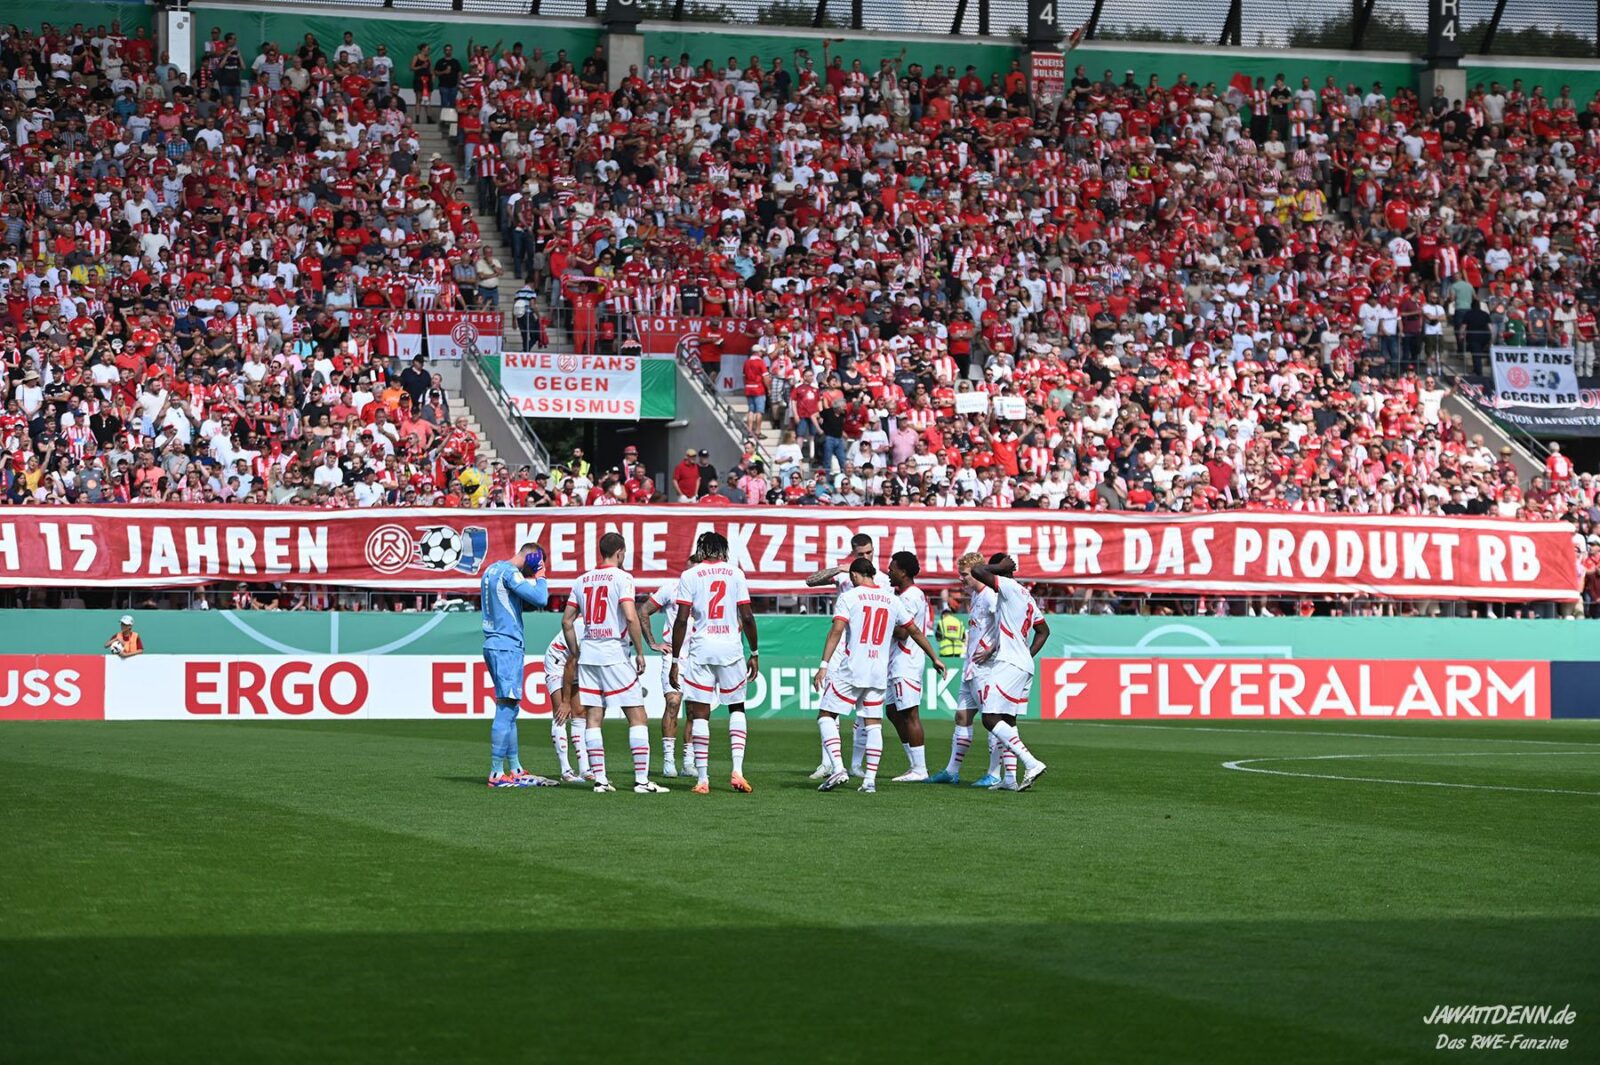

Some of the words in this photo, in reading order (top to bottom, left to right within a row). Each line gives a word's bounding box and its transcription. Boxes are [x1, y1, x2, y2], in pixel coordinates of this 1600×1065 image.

[1039, 2, 1055, 25] 4
[1441, 19, 1457, 42] 4
[1033, 58, 1064, 68] SCHEISS
[1033, 69, 1064, 78] BULLEN
[428, 314, 501, 323] ROT-WEISS
[641, 319, 748, 333] ROT-WSS
[505, 353, 551, 368] RWE
[582, 356, 637, 371] FANS
[1495, 352, 1528, 364] RWE
[1534, 353, 1573, 365] FANS
[533, 376, 609, 392] GEGEN
[1501, 391, 1550, 403] GEGEN
[1556, 393, 1577, 404] RB
[39, 522, 98, 572] 15
[122, 525, 328, 575] JAHREN
[515, 522, 668, 572] KEINE
[1006, 525, 1104, 574] FÜR
[1122, 526, 1214, 576] DAS
[1233, 528, 1460, 581] PRODUKT
[1478, 535, 1541, 582] RB
[583, 586, 608, 625] 16
[708, 580, 727, 620] 2
[860, 605, 889, 646] 10
[185, 661, 369, 715] ERGO
[1120, 664, 1537, 717] FLYERALARM
